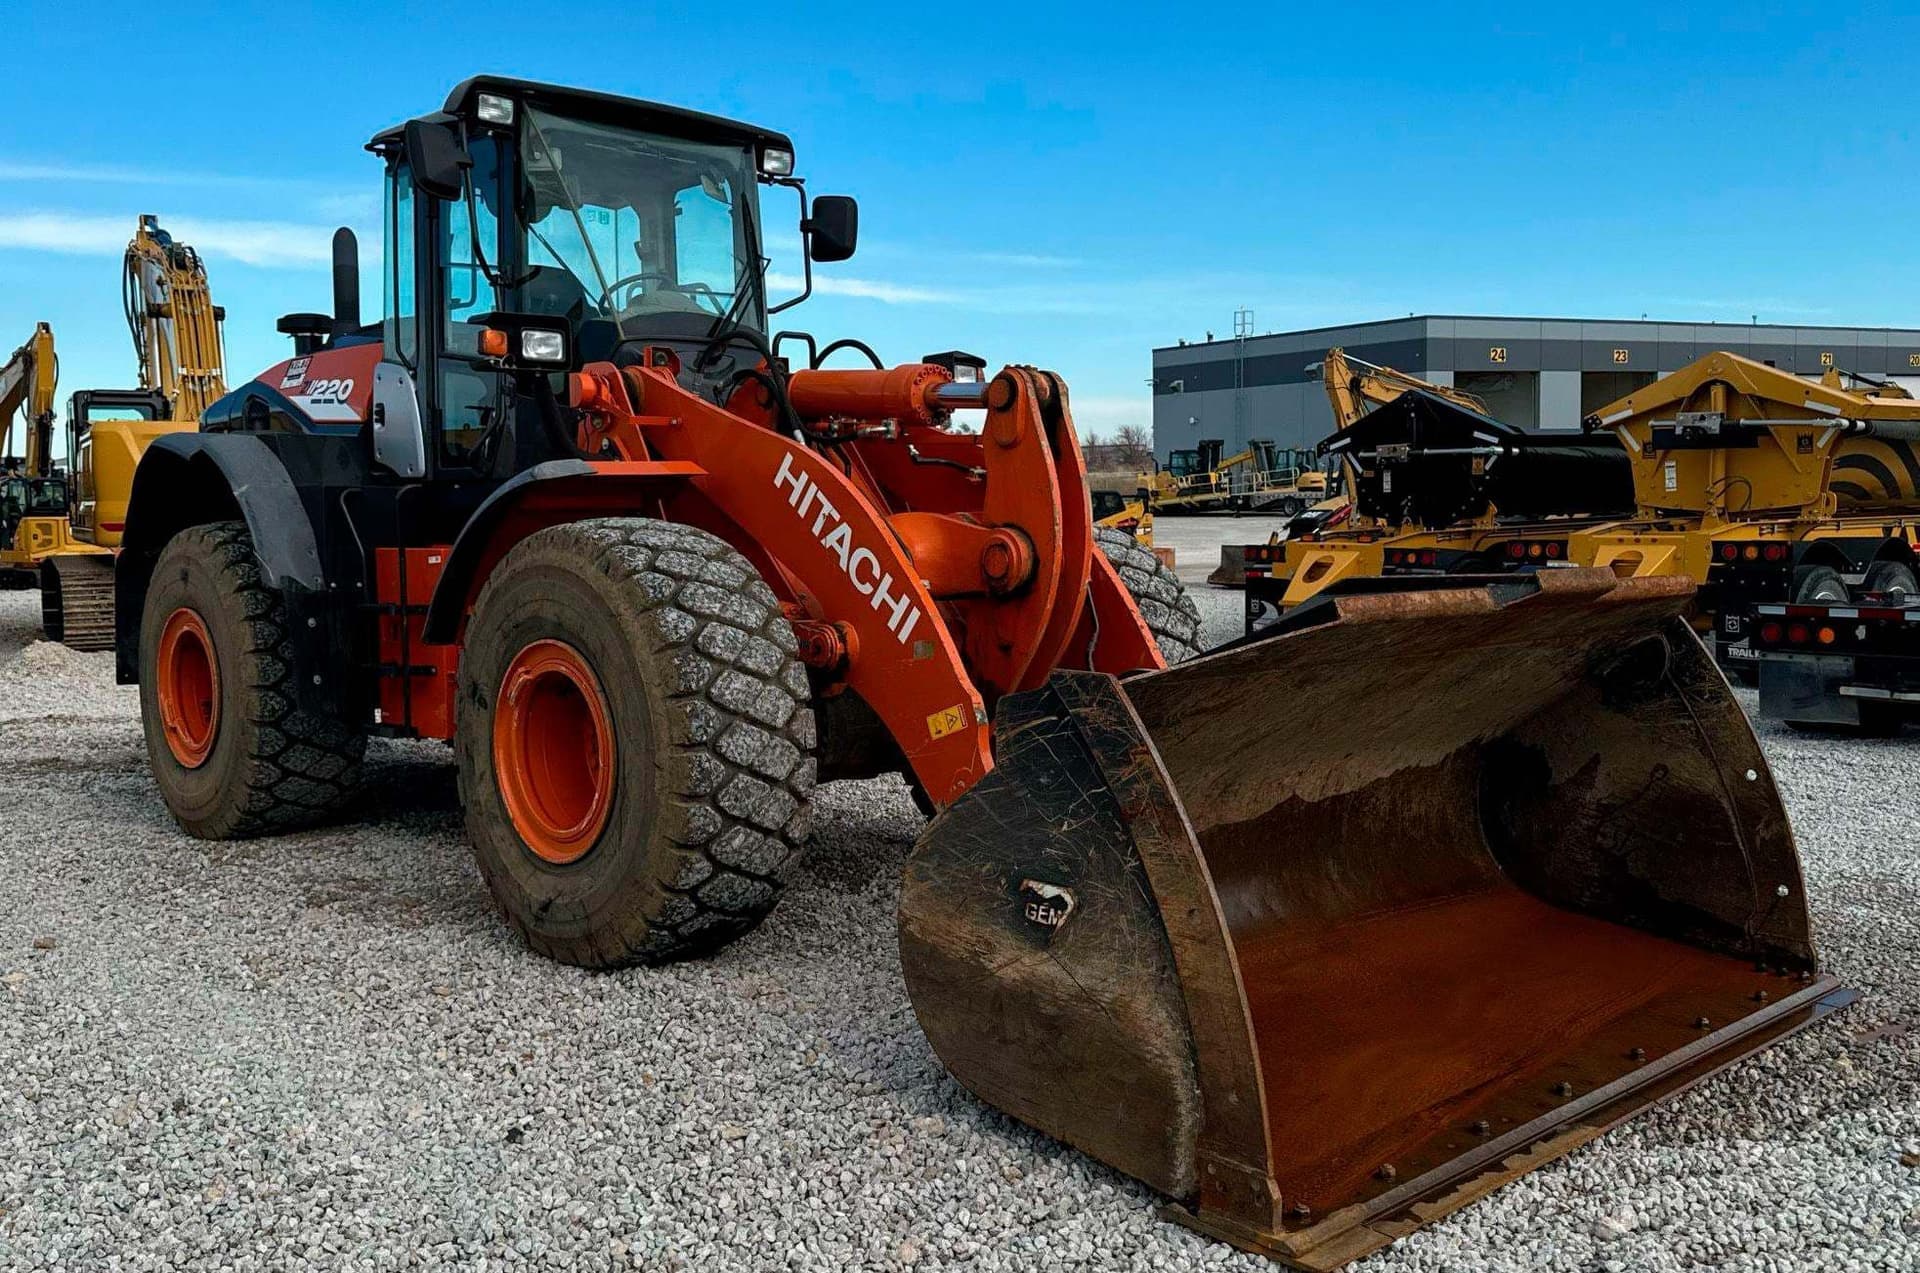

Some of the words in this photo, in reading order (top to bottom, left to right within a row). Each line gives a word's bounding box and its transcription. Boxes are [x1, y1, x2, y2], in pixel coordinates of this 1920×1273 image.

[1491, 349, 1506, 361] 24
[1615, 350, 1627, 362] 23
[1823, 354, 1832, 364] 21
[773, 451, 921, 645] HITACHI
